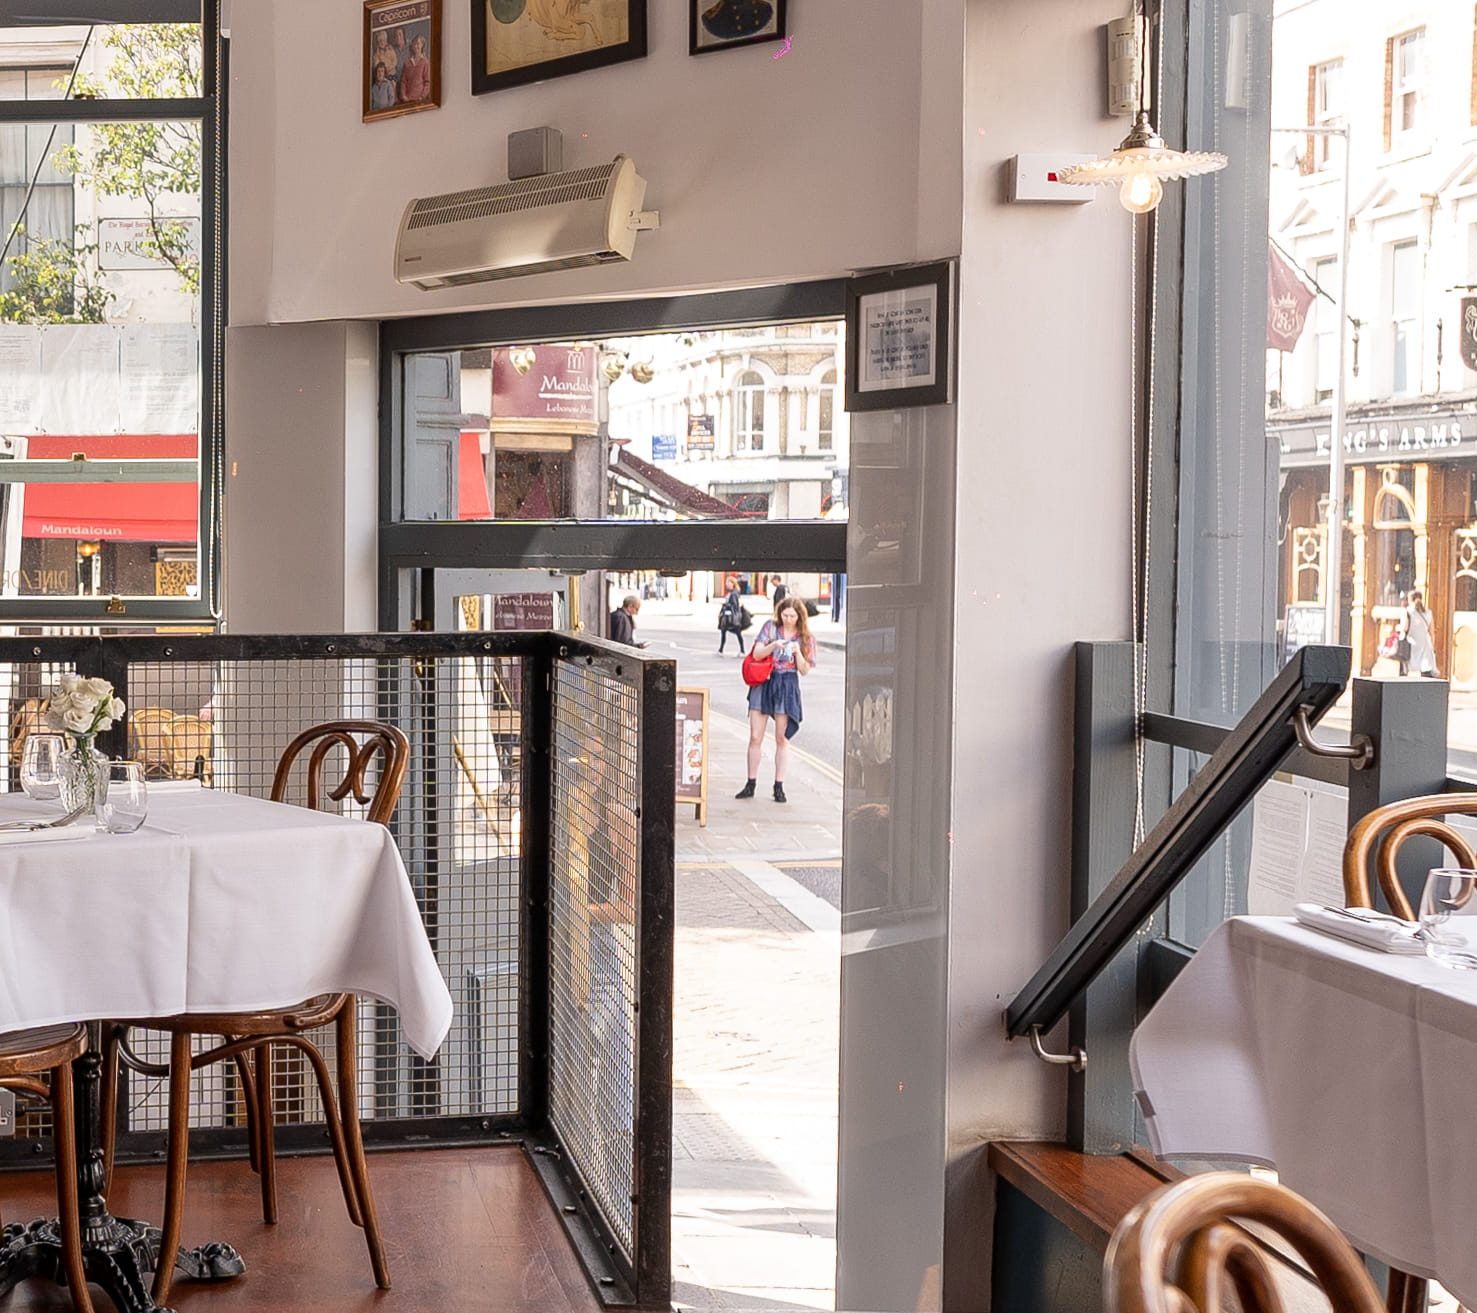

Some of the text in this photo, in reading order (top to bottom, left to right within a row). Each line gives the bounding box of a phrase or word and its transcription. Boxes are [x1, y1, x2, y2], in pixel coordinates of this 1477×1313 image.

[1316, 422, 1462, 457] KNG'S ARMS
[41, 524, 122, 536] Mandaloun
